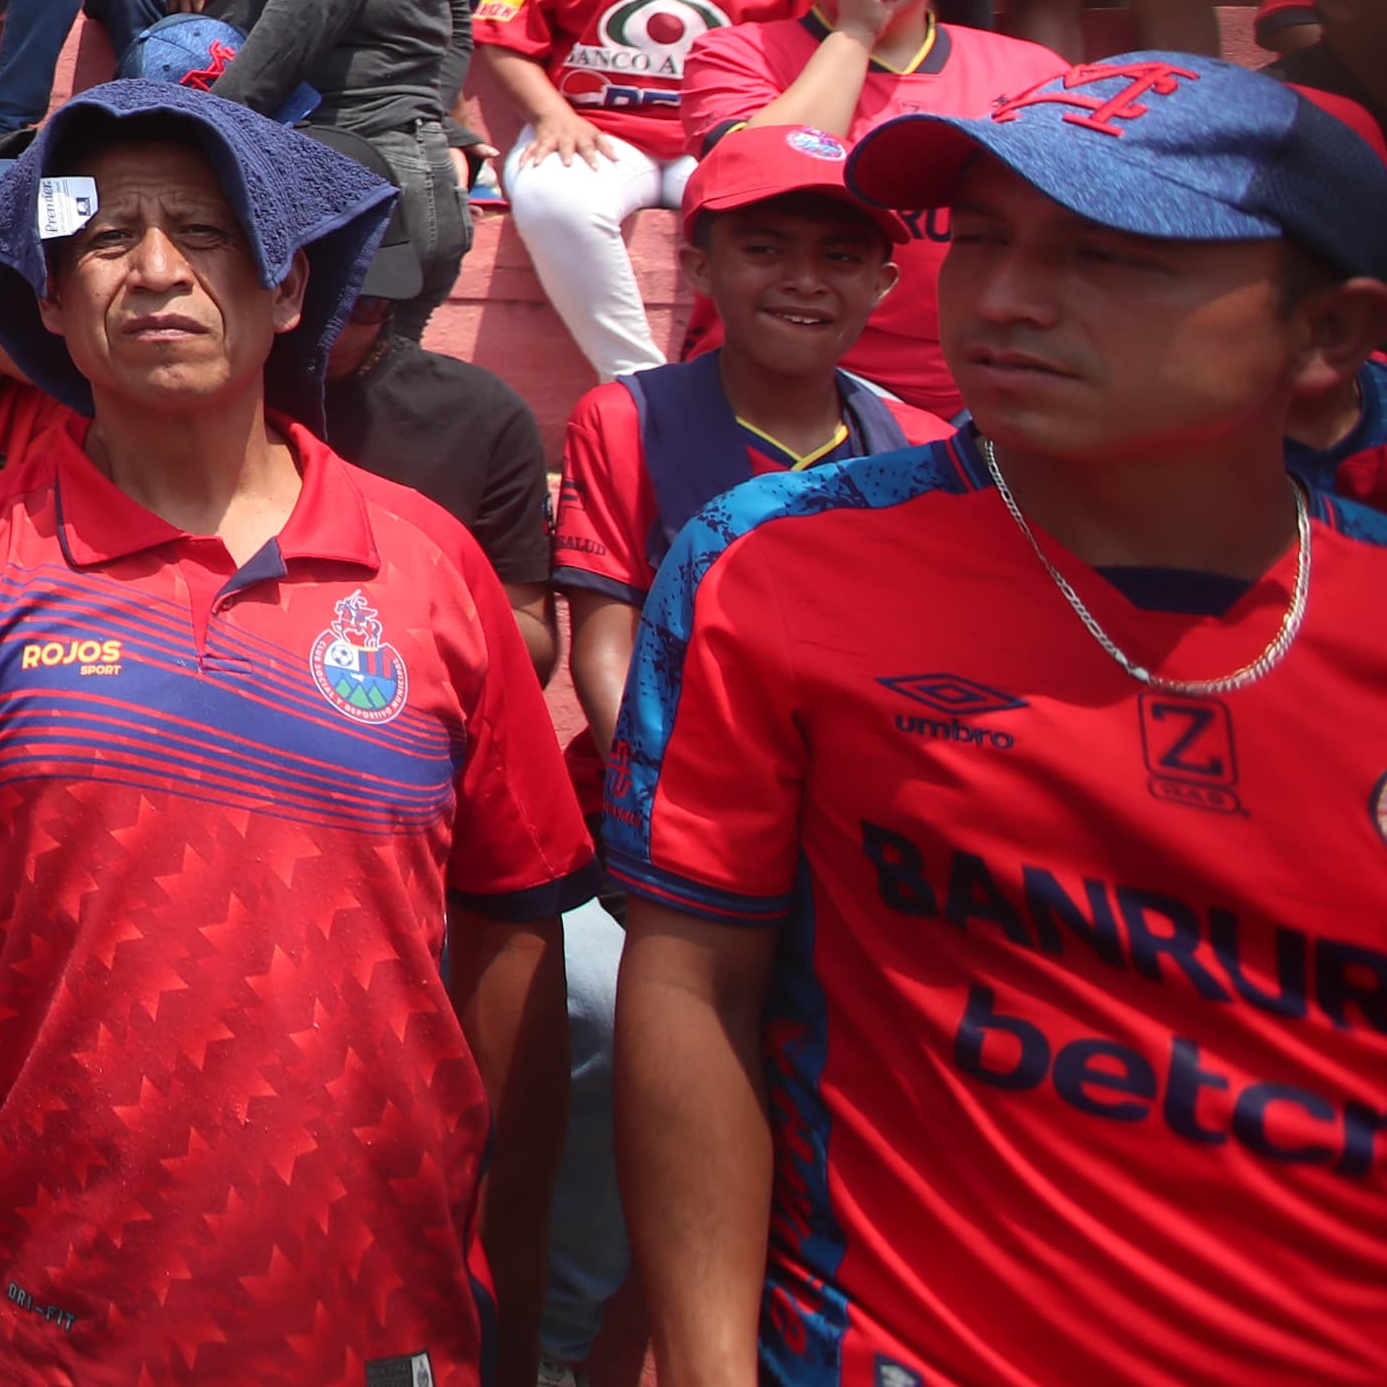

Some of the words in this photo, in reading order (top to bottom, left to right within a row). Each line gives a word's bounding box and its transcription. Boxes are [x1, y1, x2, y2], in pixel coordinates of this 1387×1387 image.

[21, 639, 123, 670] ROJOS
[79, 664, 122, 676] SPORT
[893, 712, 1015, 750] umbro
[1151, 702, 1224, 778] Z
[1161, 781, 1225, 807] GAS
[859, 817, 1387, 1033] BANRUR
[953, 983, 1387, 1179] betcr
[8, 1281, 76, 1332] DRI-FIT
